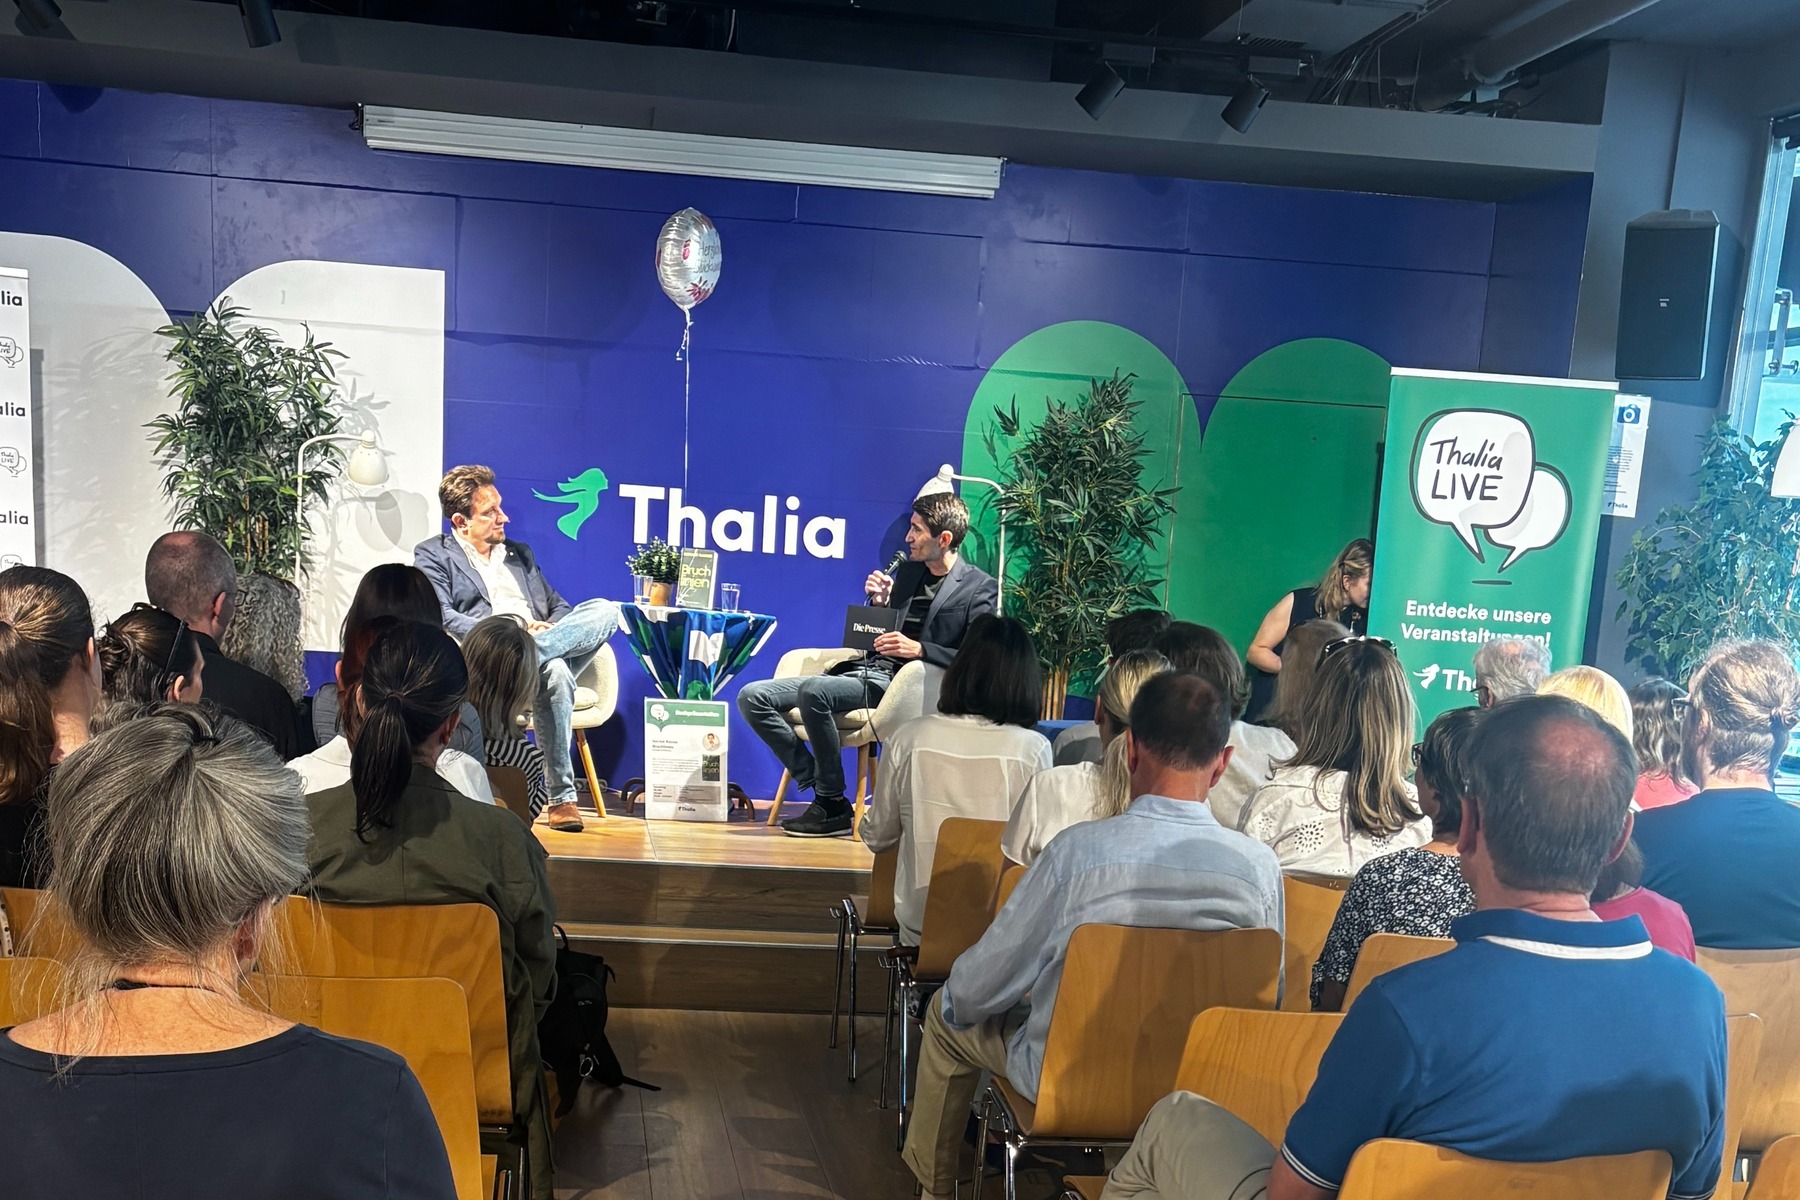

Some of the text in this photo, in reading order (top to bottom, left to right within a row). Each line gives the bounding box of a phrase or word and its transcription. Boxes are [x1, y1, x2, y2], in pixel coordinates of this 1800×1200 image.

[1429, 436, 1503, 471] Thalia
[1431, 469, 1504, 501] LIVE
[619, 483, 847, 560] Thalia
[681, 563, 712, 577] Bruch
[1405, 600, 1552, 625] Entdecke unsere
[853, 622, 865, 632] Die
